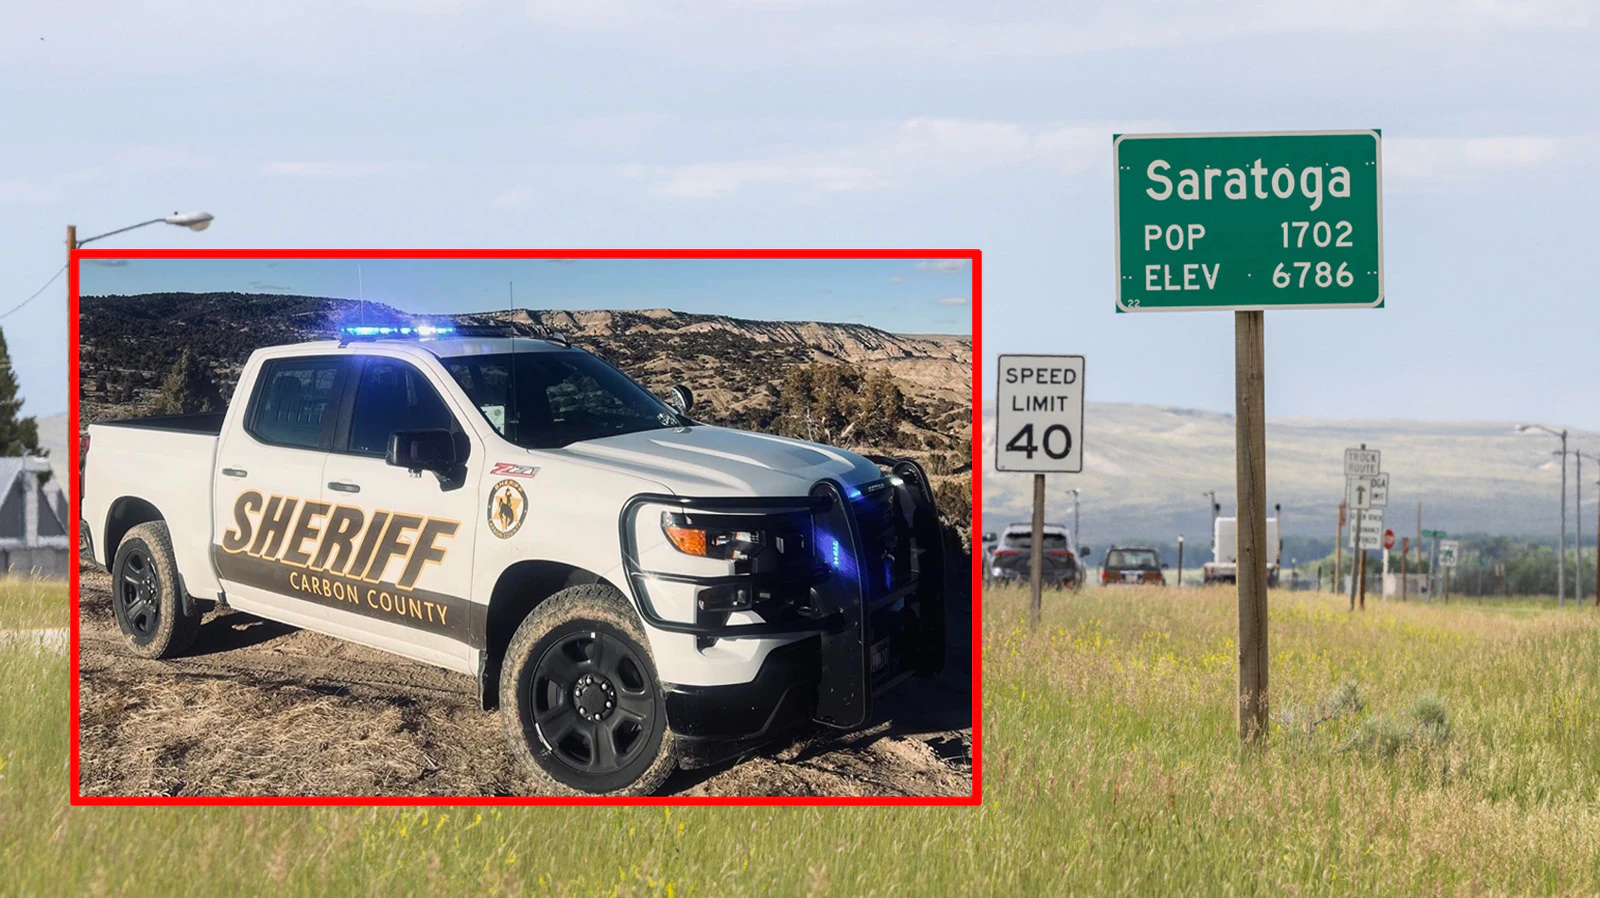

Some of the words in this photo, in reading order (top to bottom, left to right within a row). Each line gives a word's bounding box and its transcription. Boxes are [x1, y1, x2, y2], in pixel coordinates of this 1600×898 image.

[1145, 158, 1351, 212] Saratoga
[1144, 223, 1206, 251] POP
[1281, 220, 1353, 249] 1702
[1145, 263, 1220, 291] ELEV
[1271, 261, 1355, 289] 6786
[1127, 299, 1141, 308] 22
[1005, 367, 1077, 385] SPEED
[1012, 395, 1068, 412] LIMIT
[1005, 423, 1072, 460] 40
[1348, 463, 1375, 474] ROUTE
[1349, 452, 1377, 463] TRUCK
[222, 489, 462, 592] SHERIFF
[289, 571, 360, 605] CARBON
[366, 588, 449, 626] COUNTY
